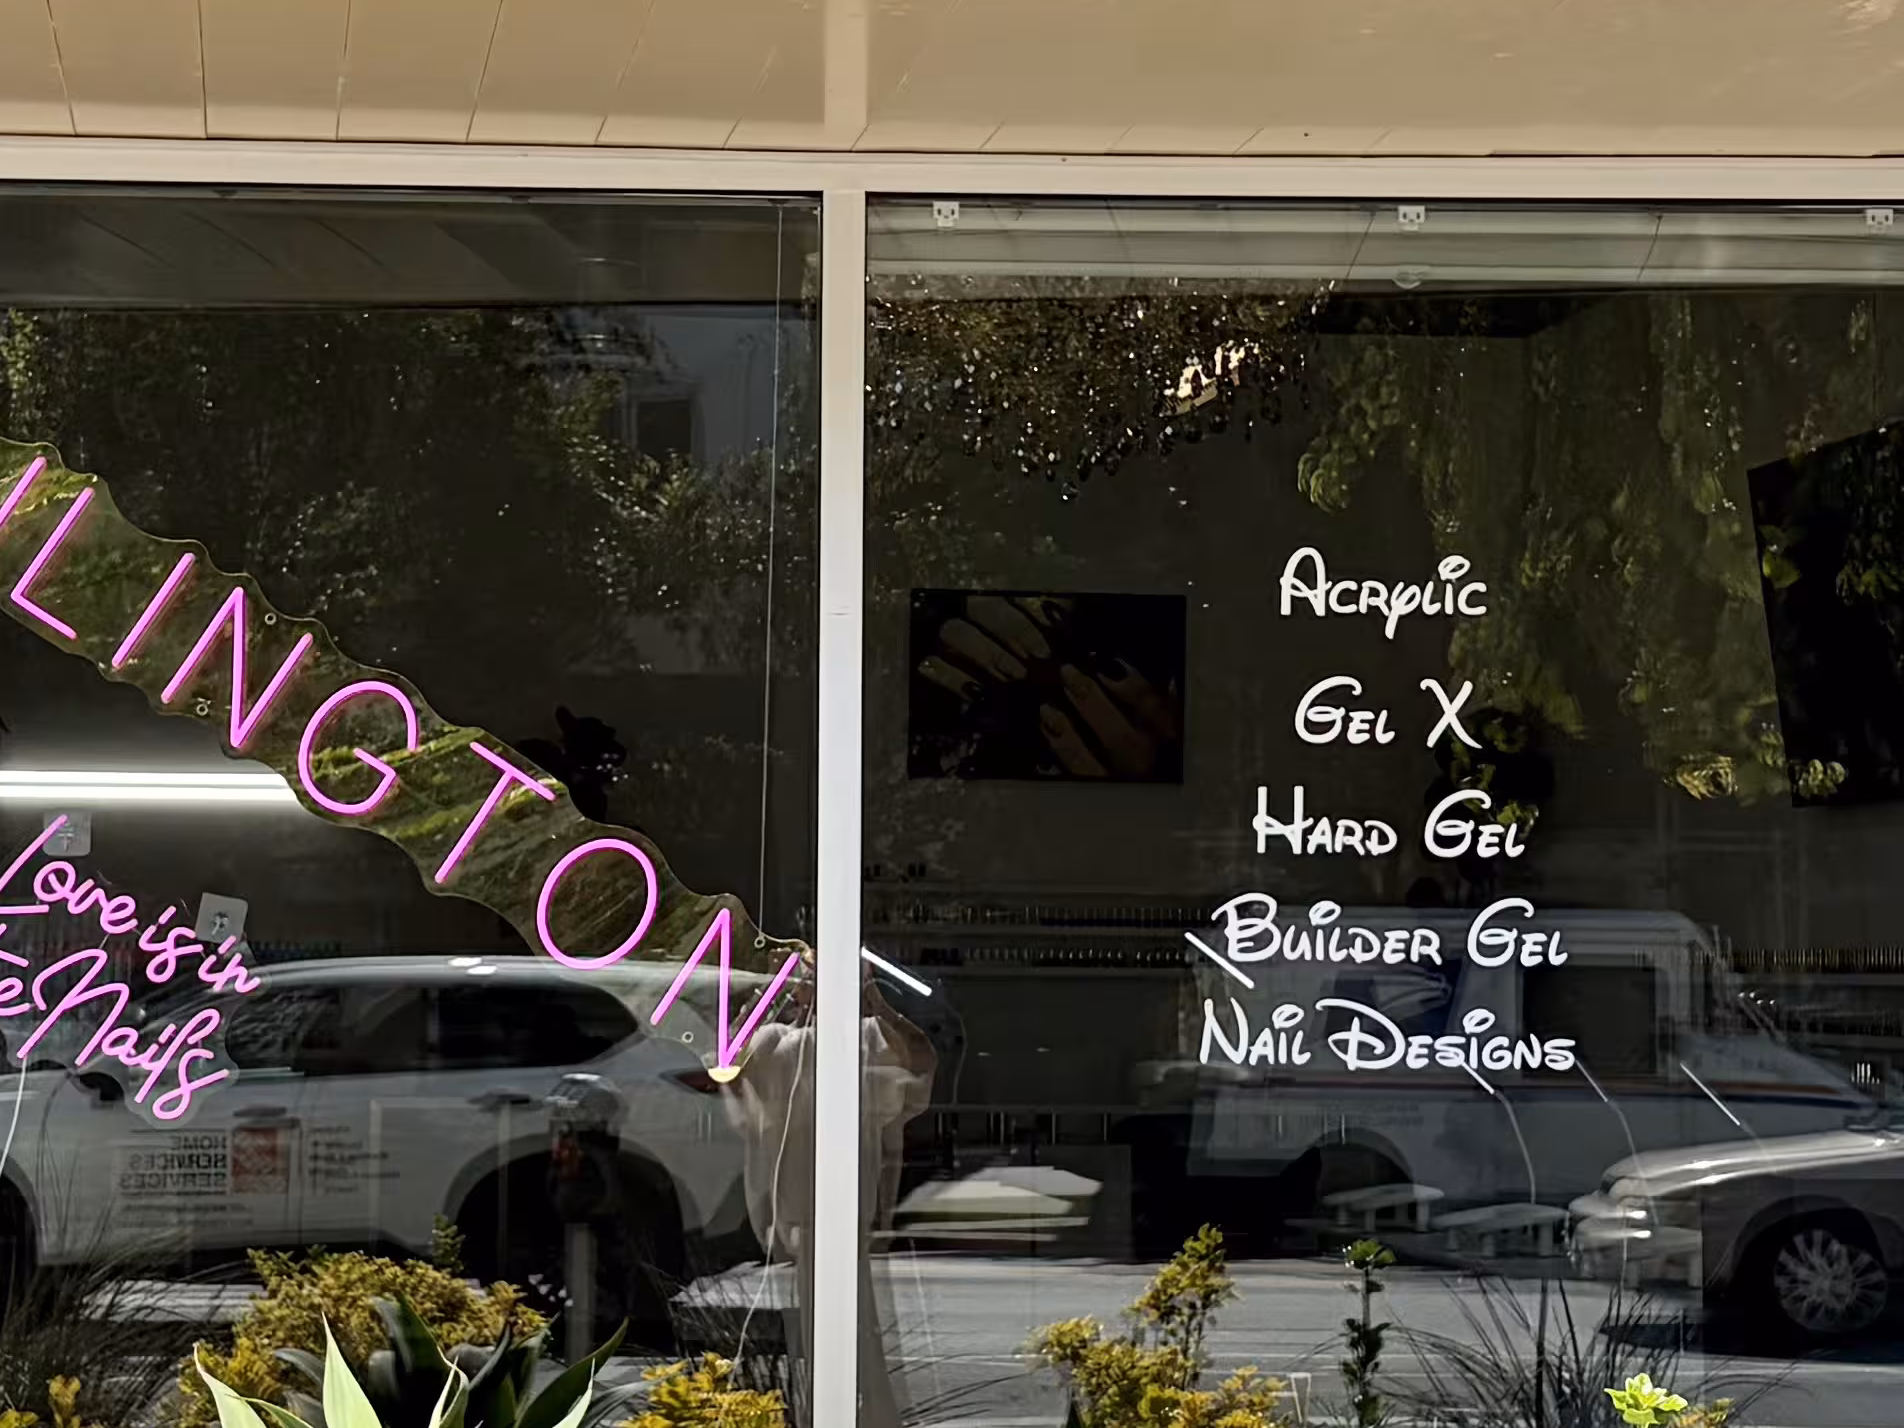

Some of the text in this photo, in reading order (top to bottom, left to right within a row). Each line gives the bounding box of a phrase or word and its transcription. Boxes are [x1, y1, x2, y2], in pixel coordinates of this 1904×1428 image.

[1280, 547, 1487, 639] Acrylic
[1295, 676, 1482, 749] Gel X
[1252, 785, 1526, 859] Hard Gel
[138, 905, 204, 983] is
[198, 935, 262, 993] in
[1212, 893, 1569, 967] Builder Gel
[16, 948, 230, 1120] Nails
[1199, 997, 1576, 1071] Nail Designs
